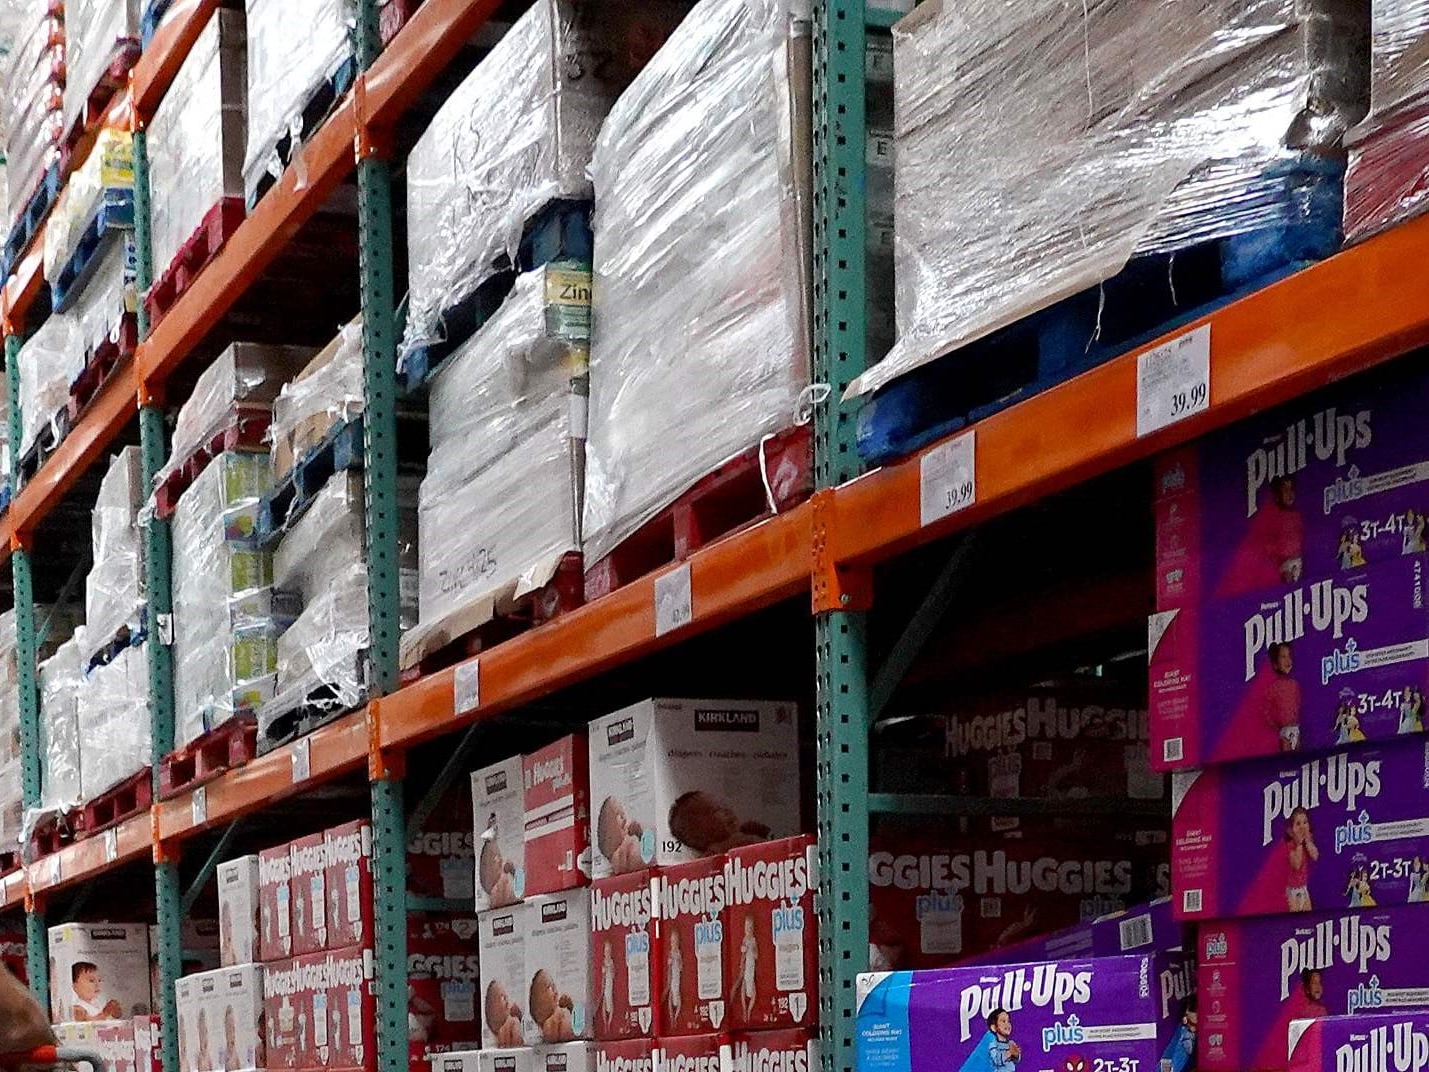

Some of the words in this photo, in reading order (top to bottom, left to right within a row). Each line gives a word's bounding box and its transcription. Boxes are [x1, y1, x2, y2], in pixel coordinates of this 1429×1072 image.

[559, 284, 592, 301] Zin
[1171, 384, 1207, 416] 39.99
[944, 482, 974, 510] 39.99
[1360, 513, 1407, 541] 3T-4T
[1322, 646, 1362, 685] plus
[1357, 688, 1403, 714] 3T-4T
[697, 711, 758, 725] KIRKLAND
[662, 841, 682, 853] 192
[1335, 815, 1373, 854] plus
[726, 855, 807, 906] HUGGIES
[869, 851, 970, 890] GGIES
[973, 850, 1133, 894] HUGGIES
[1370, 858, 1412, 881] 2T-3T
[591, 887, 651, 932] HUGGIES
[658, 874, 725, 920] HUGGIES
[772, 905, 804, 938] plus
[408, 953, 480, 979] GGIES
[1348, 980, 1384, 1014] plus
[1042, 1018, 1085, 1052] plus
